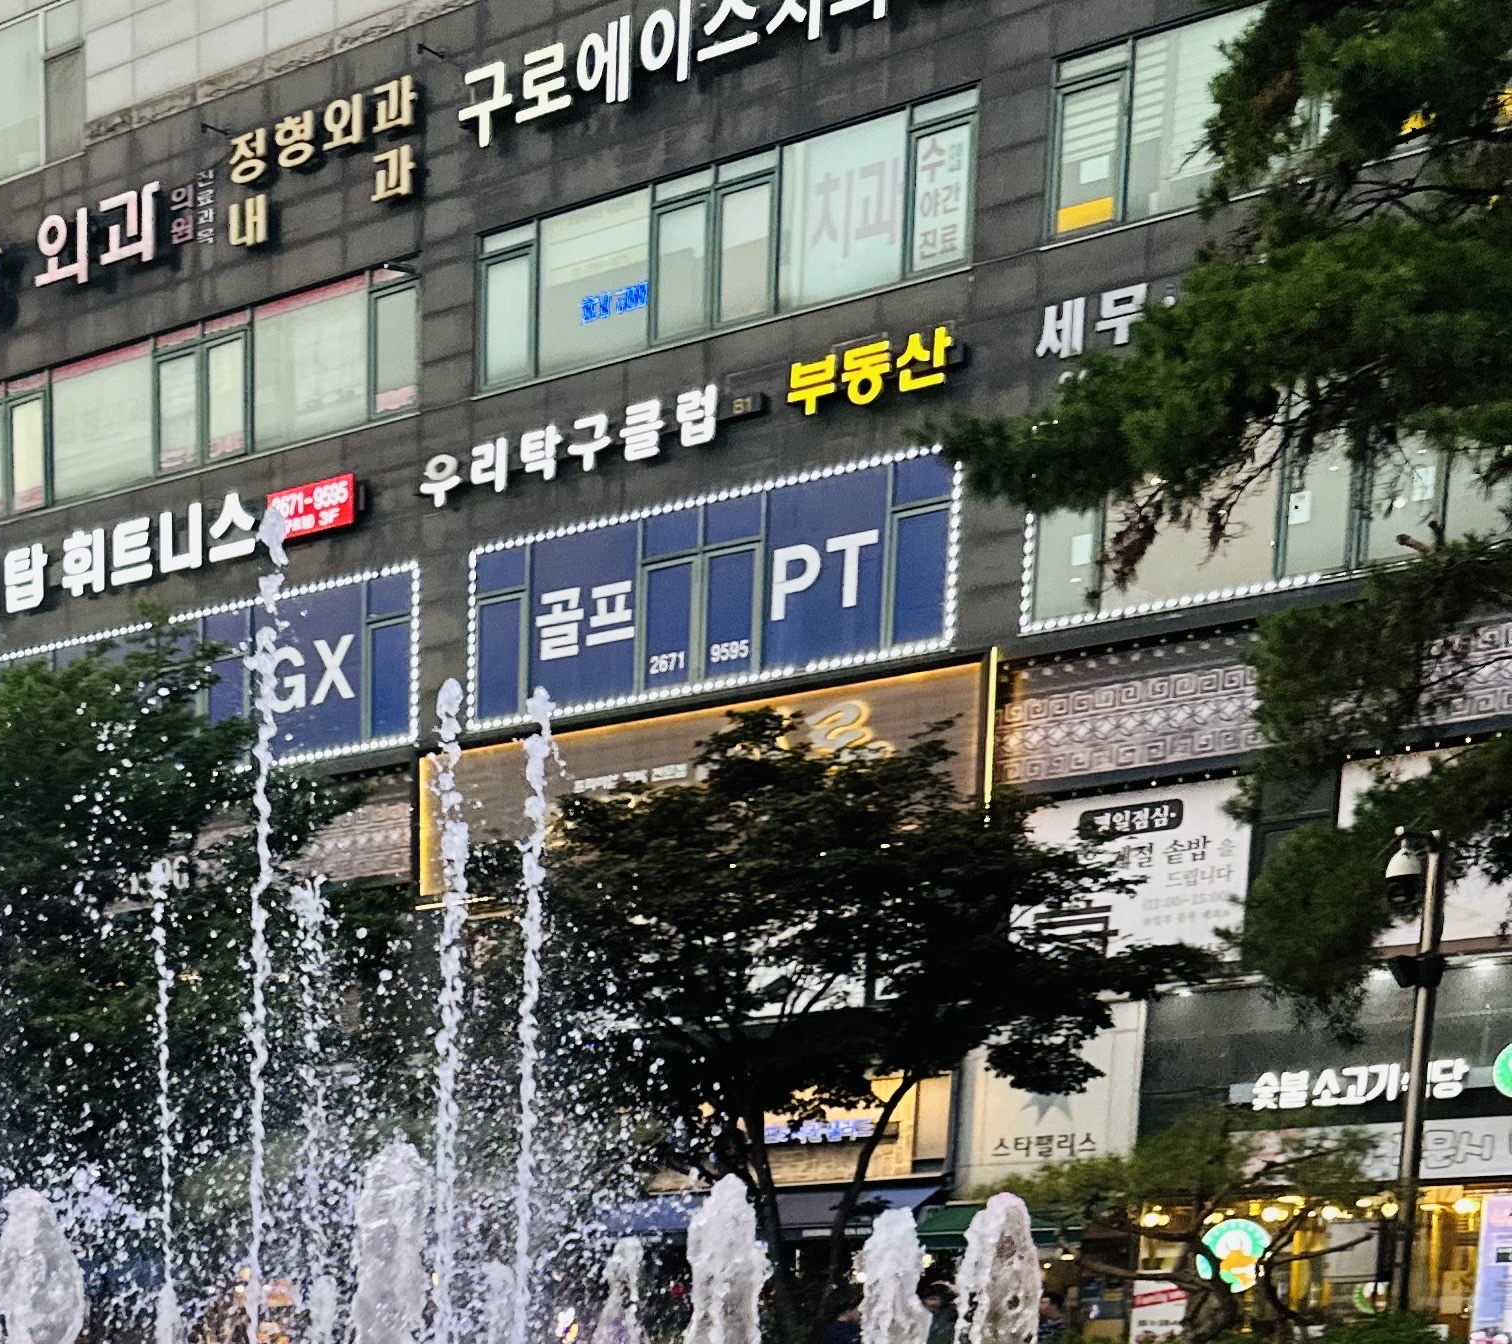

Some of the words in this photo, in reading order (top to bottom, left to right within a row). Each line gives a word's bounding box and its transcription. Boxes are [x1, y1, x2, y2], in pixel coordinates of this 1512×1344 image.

[458, 0, 888, 148] 구로에이스
[229, 74, 418, 184] 정형외과
[810, 156, 903, 259] 치과
[918, 224, 958, 260] 진료
[787, 325, 953, 415] 부동산
[419, 382, 719, 508] 우리탁구클럽
[61, 492, 257, 597] 휘트니스
[768, 529, 880, 622] PT
[535, 580, 635, 661] 골프
[649, 651, 686, 675] 2671
[709, 639, 750, 664] 9595
[267, 633, 357, 714] GX
[1252, 1058, 1471, 1111] 숯불소고기당
